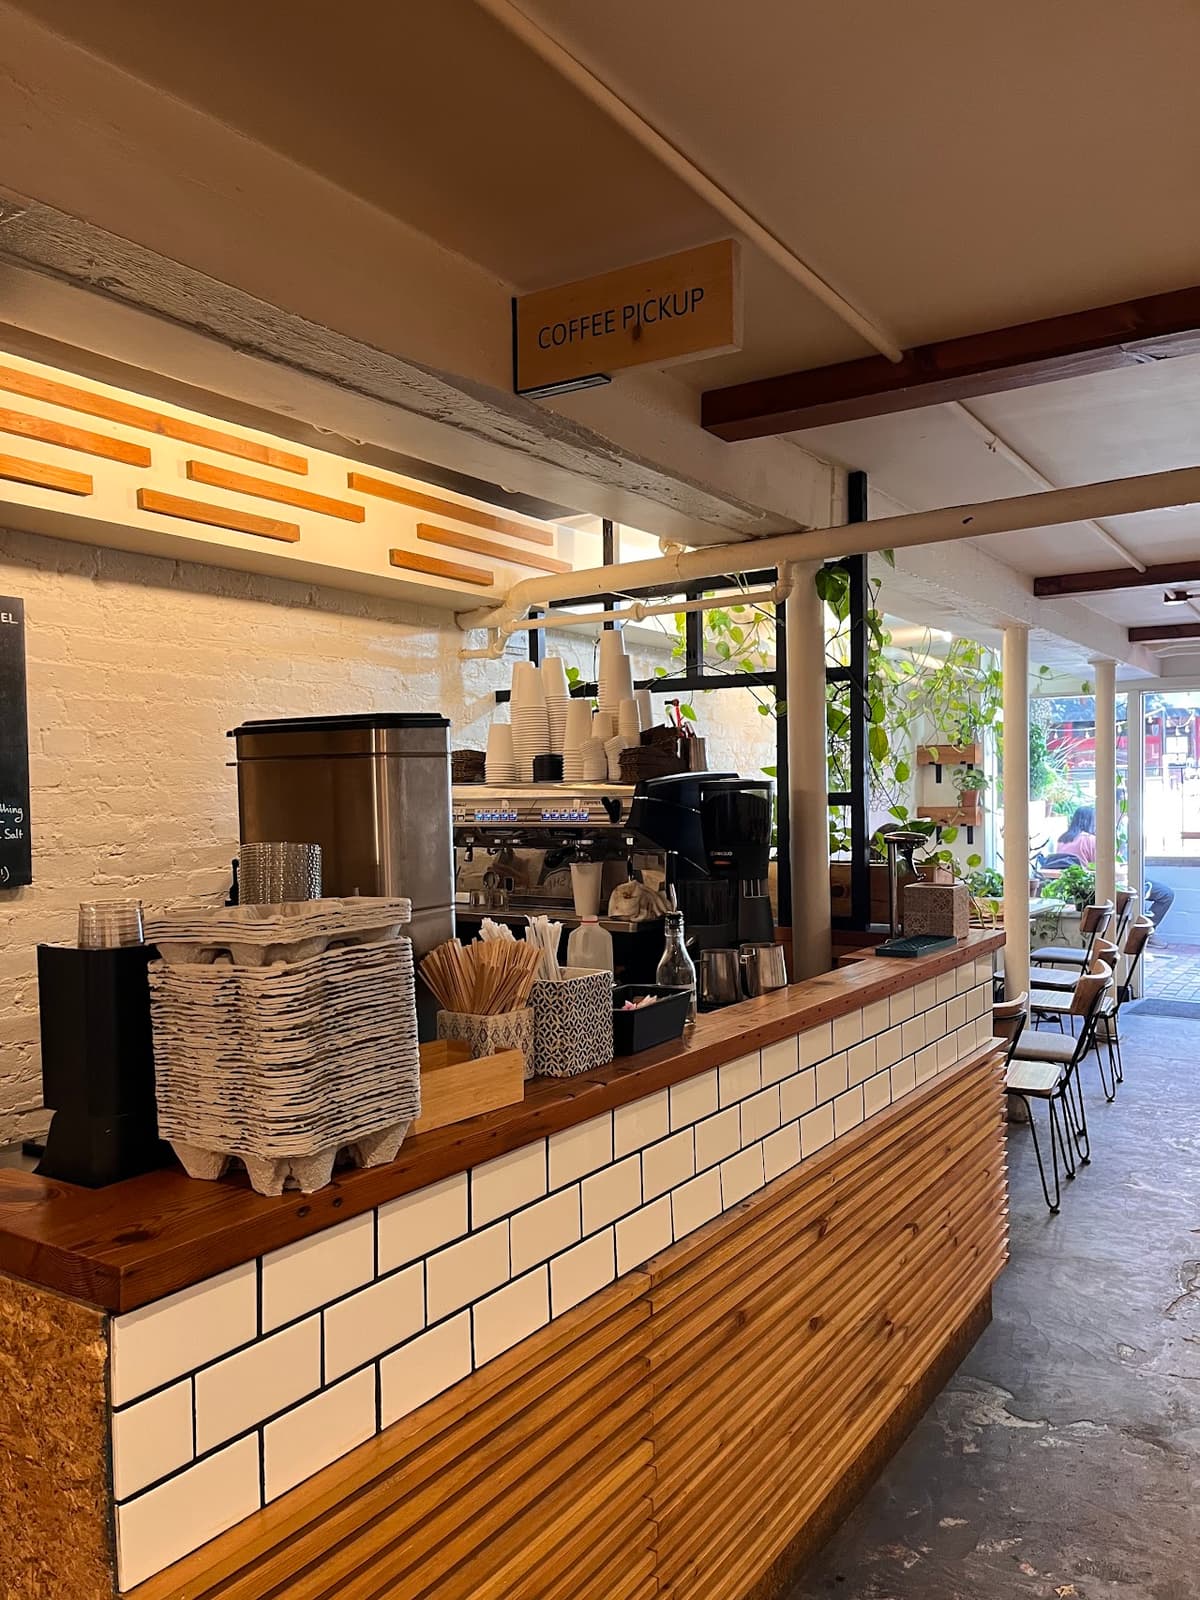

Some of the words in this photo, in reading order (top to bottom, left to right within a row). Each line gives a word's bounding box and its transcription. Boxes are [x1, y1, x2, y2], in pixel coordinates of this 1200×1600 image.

[538, 309, 616, 349] COFFEE
[622, 287, 704, 329] PICKUP
[4, 828, 24, 840] Salt
